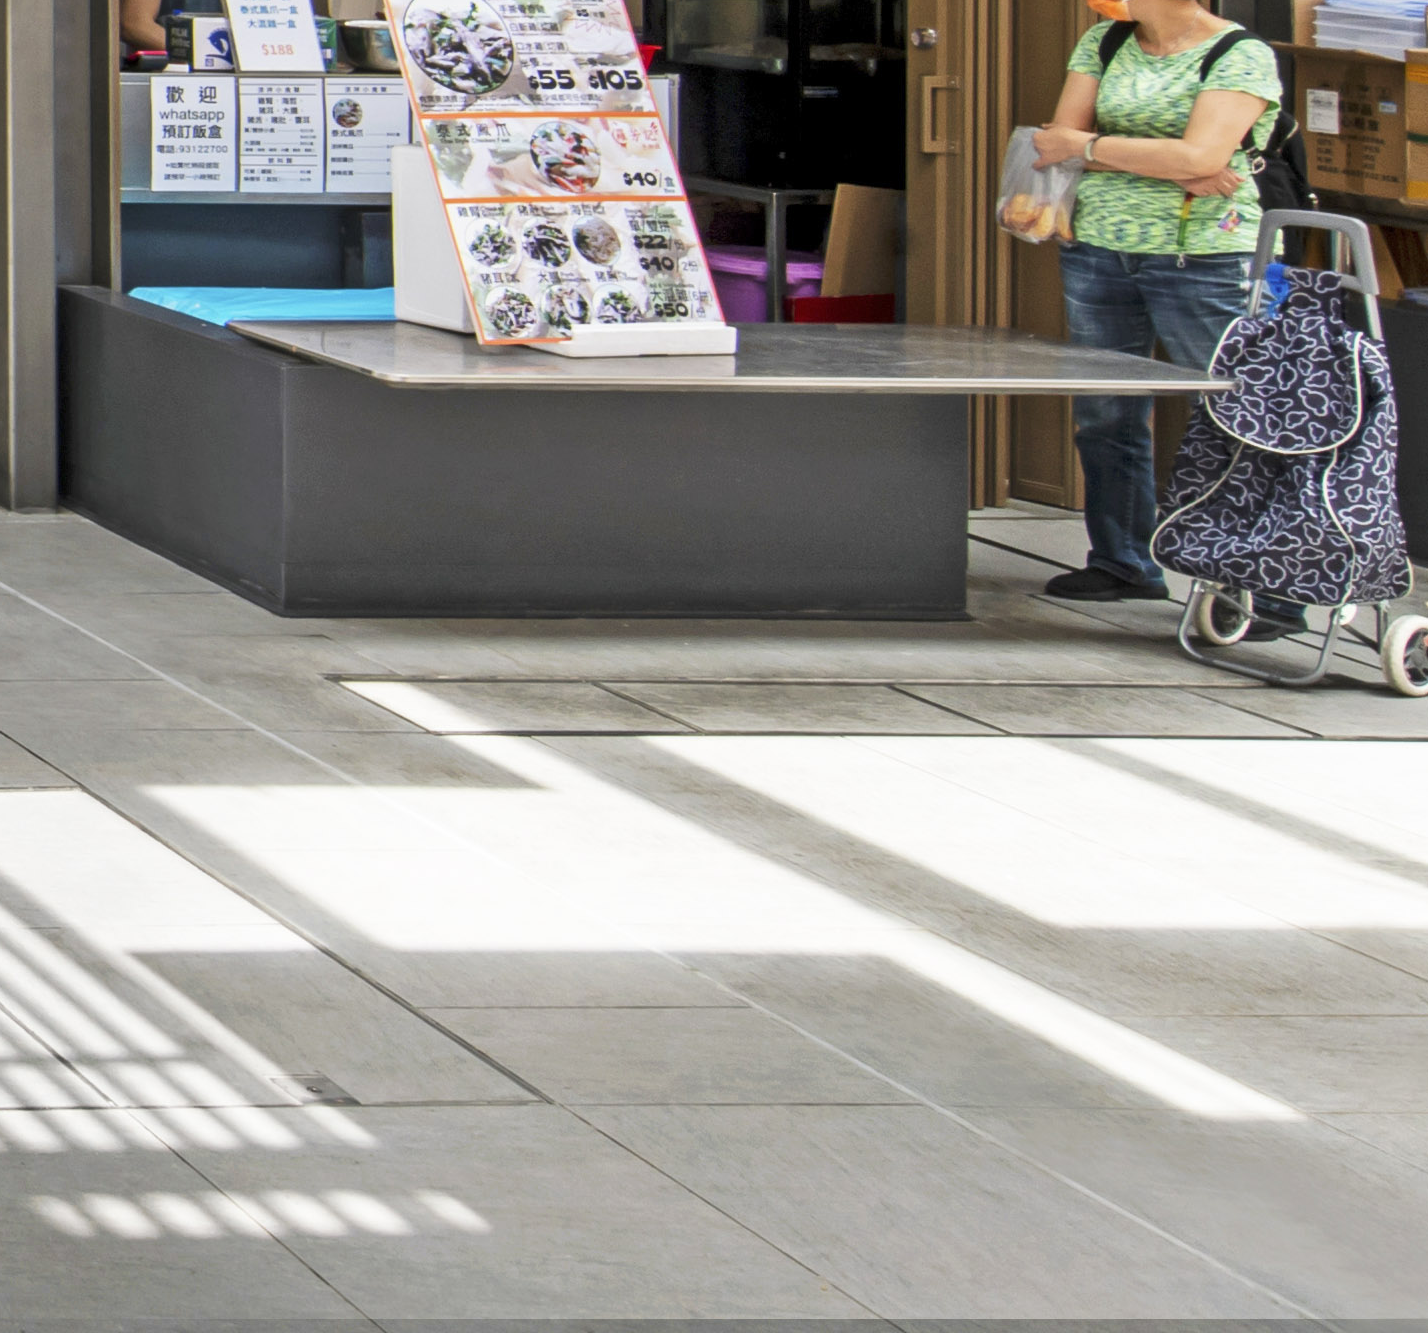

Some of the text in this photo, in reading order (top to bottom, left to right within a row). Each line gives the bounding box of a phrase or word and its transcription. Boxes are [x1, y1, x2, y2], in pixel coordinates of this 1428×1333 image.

[261, 44, 294, 56] $188
[527, 70, 643, 91] $55 $105
[166, 86, 218, 104] 歡迎
[159, 109, 225, 123] whatsapp
[162, 125, 222, 139] 預訂飯盒
[623, 172, 658, 187] $40
[633, 234, 668, 249] $22
[639, 256, 675, 271] $40
[654, 303, 689, 318] $50
